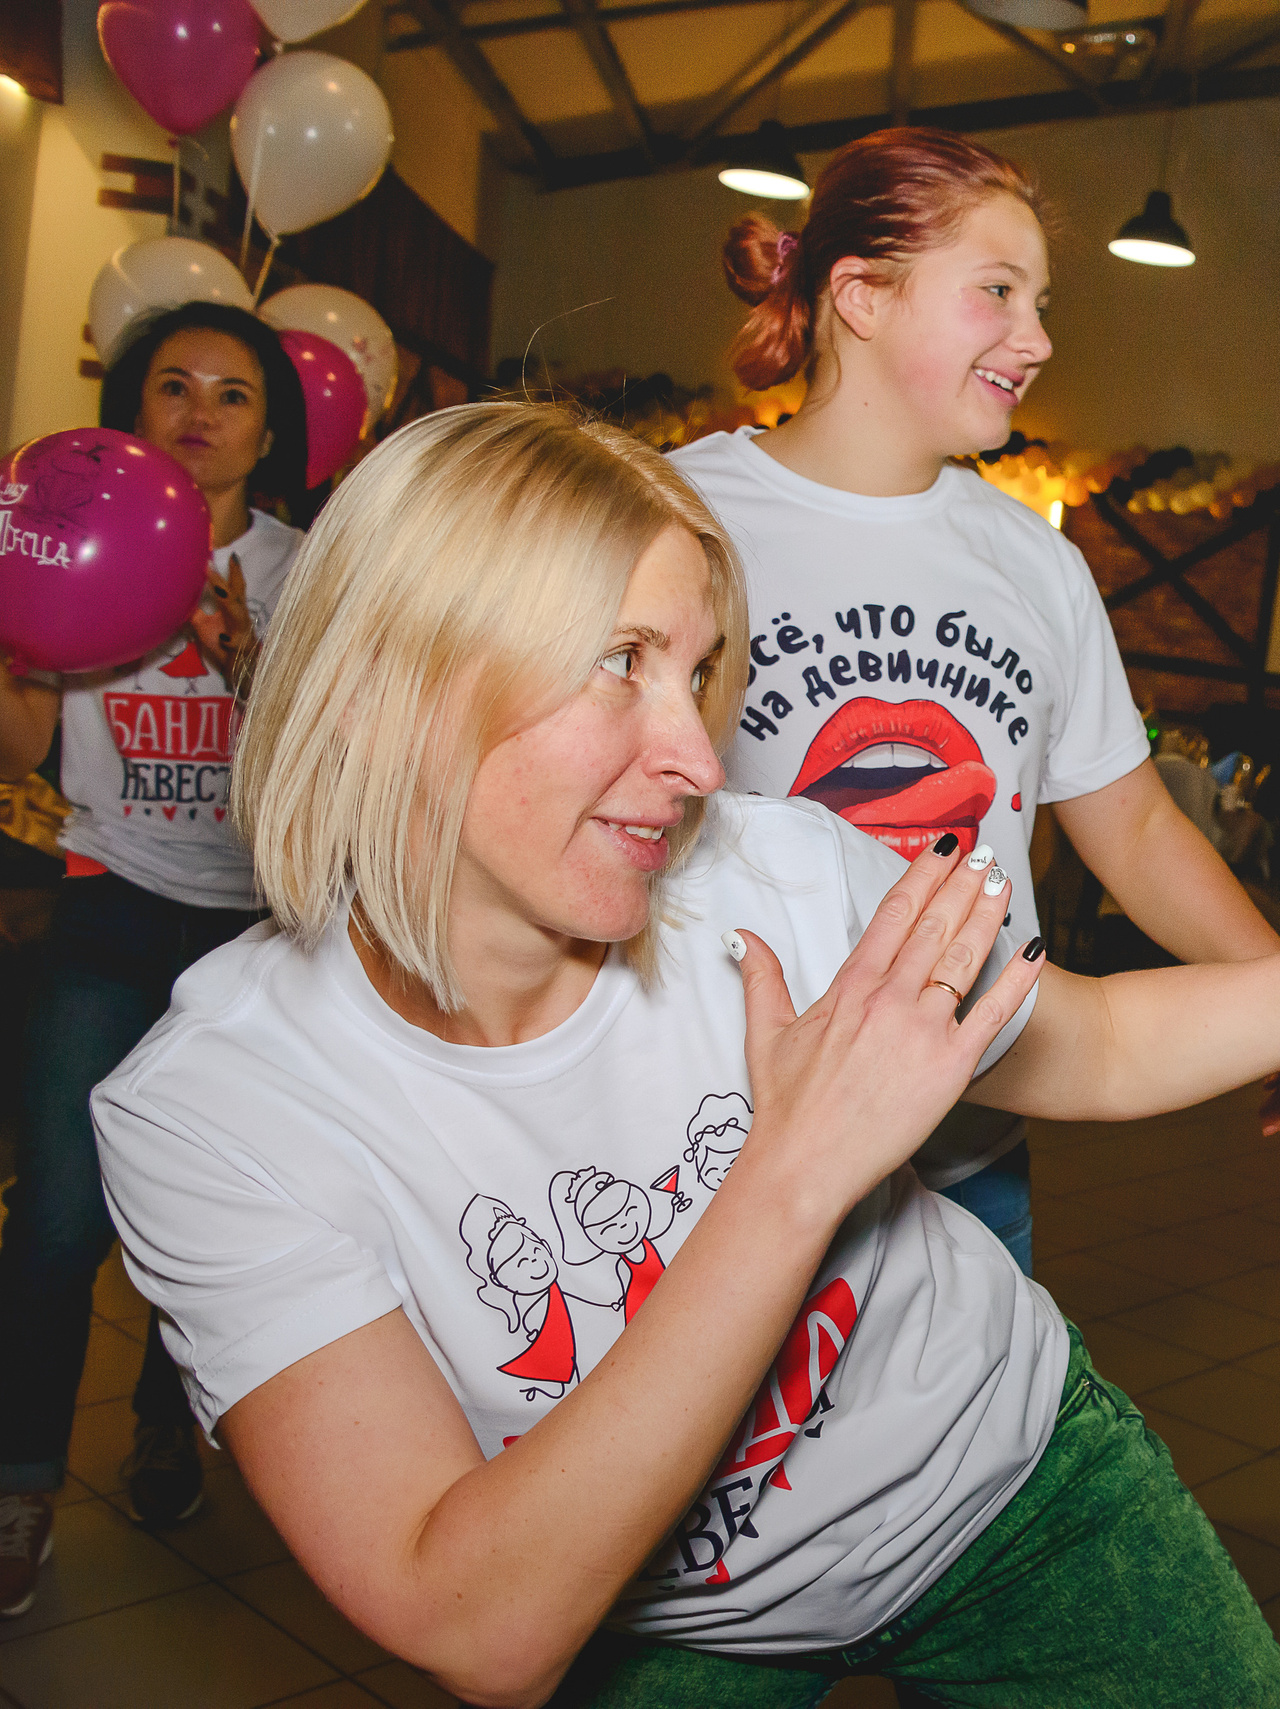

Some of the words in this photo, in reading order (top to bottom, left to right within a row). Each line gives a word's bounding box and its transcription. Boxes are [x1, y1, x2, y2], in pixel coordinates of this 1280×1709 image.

[748, 612, 824, 686] сё,
[835, 604, 915, 639] что
[936, 610, 1033, 695] было
[108, 698, 237, 757] БАНД
[740, 691, 793, 741] на
[802, 649, 1029, 745] девичнике
